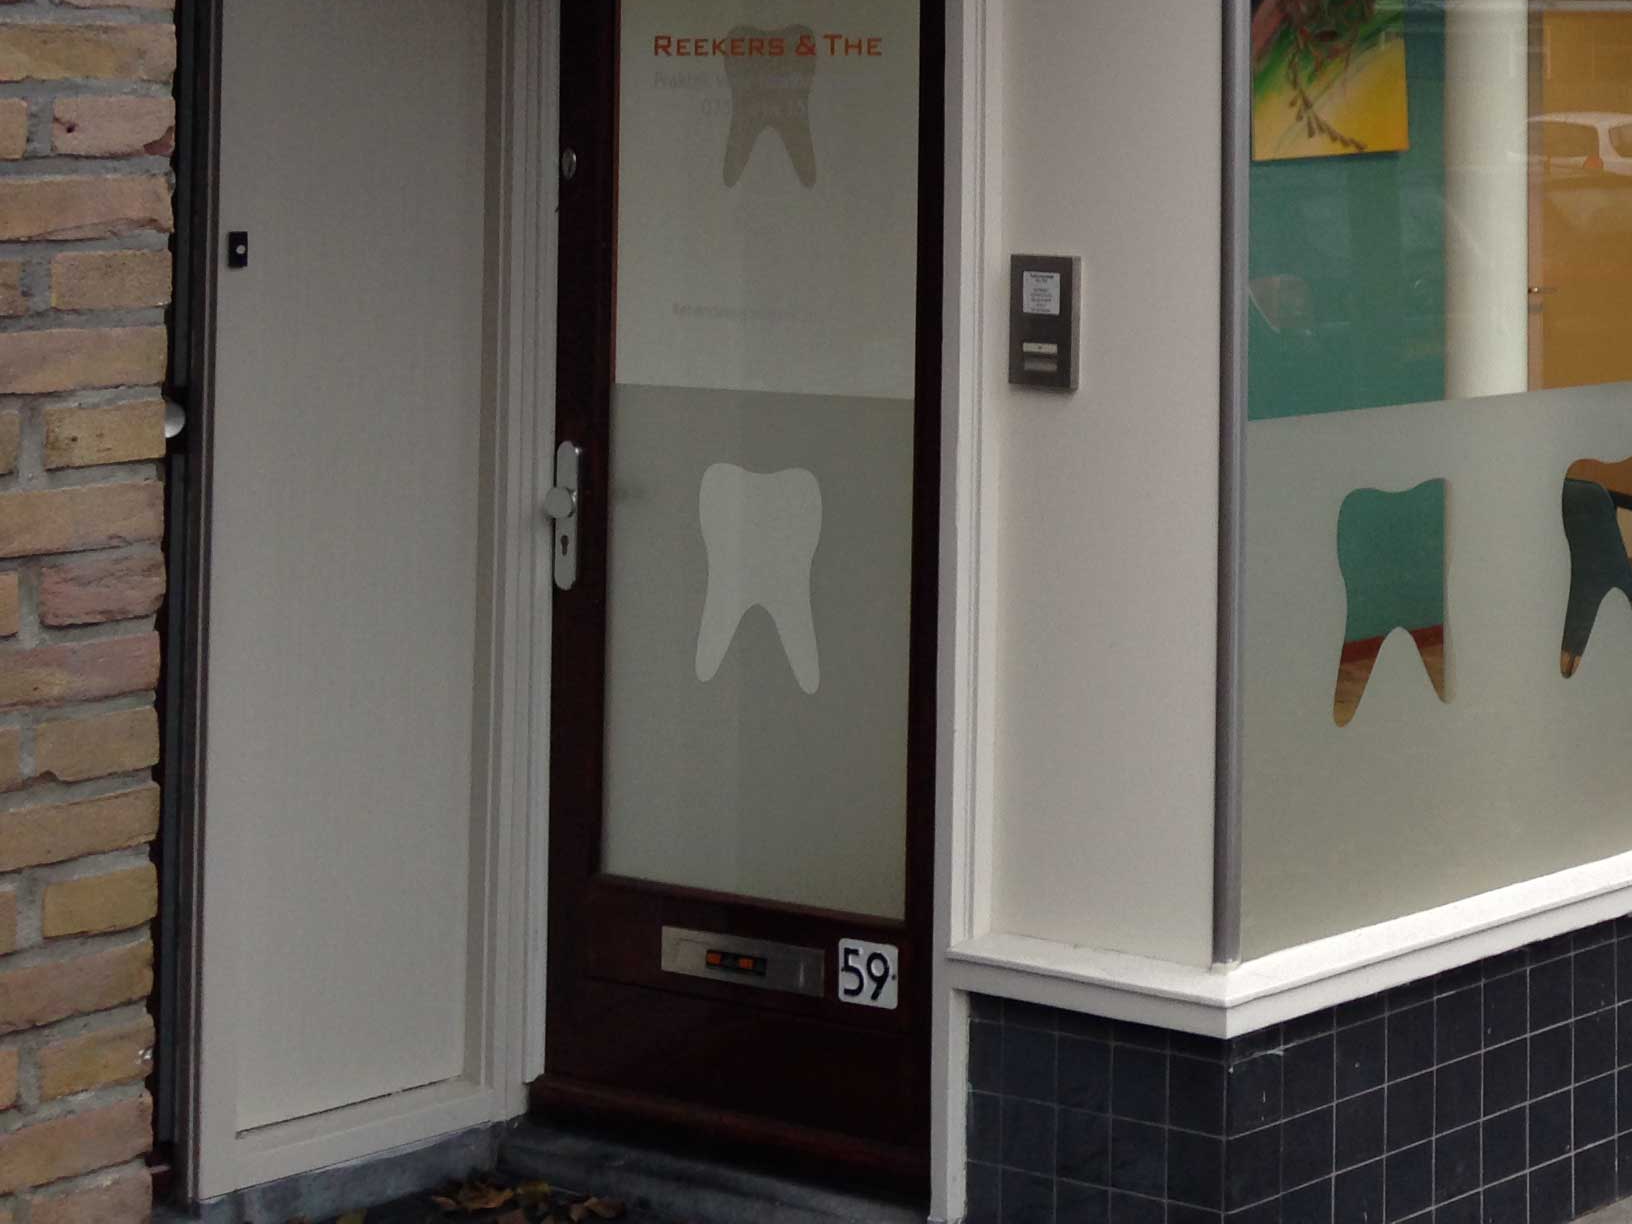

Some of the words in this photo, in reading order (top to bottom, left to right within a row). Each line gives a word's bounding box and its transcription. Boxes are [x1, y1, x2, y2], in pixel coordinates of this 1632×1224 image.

[654, 35, 784, 57] REEKERS
[795, 34, 816, 57] &
[823, 34, 882, 57] THE
[841, 947, 890, 1001] 59
